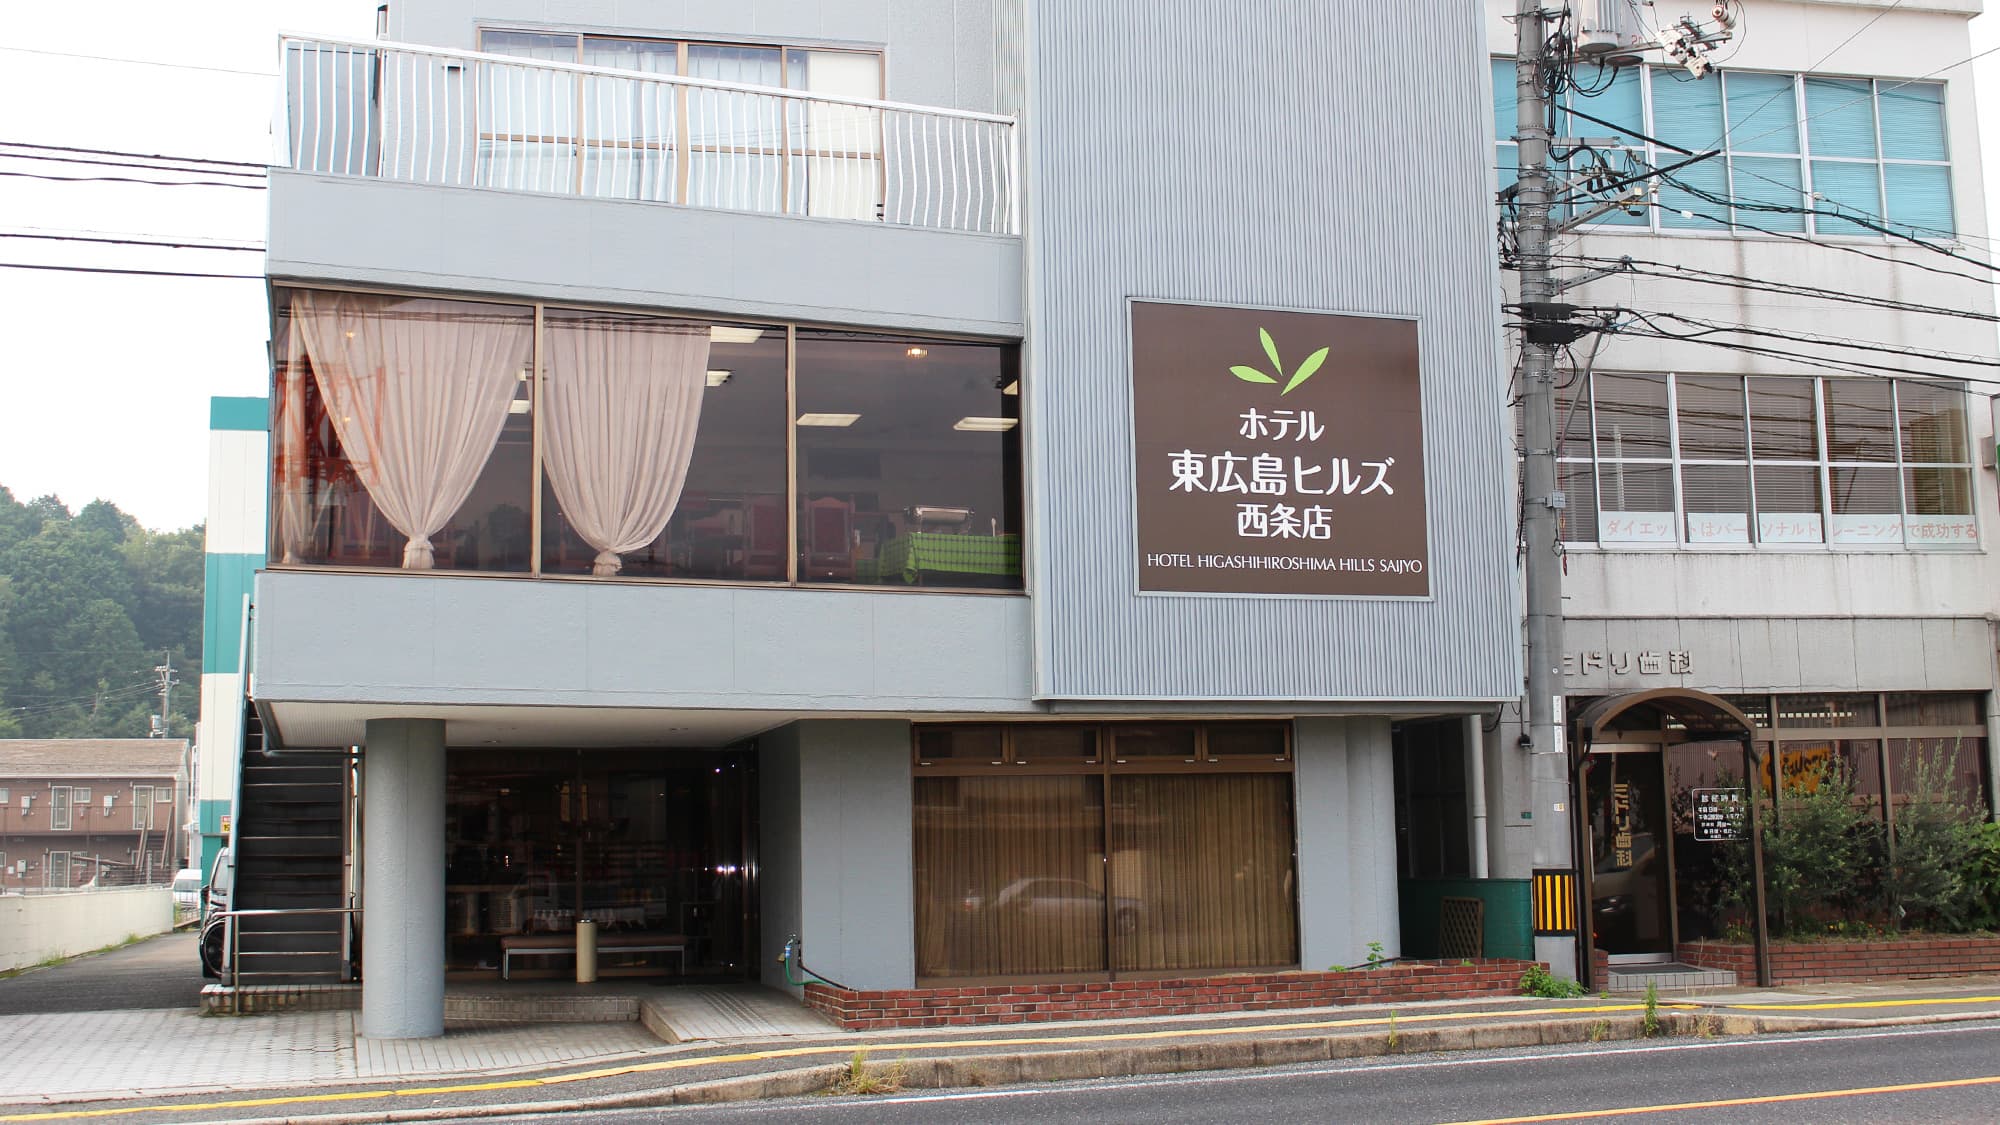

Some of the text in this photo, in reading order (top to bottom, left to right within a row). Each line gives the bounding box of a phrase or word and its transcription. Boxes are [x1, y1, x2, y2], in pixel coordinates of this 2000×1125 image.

[1239, 408, 1325, 442] ホテル
[1167, 449, 1395, 496] 東広島ヒルズ
[1236, 503, 1333, 539] 西条店
[1147, 553, 1423, 574] HOTEL HIGASHIHIROSHIMA HILLS SAIJYO
